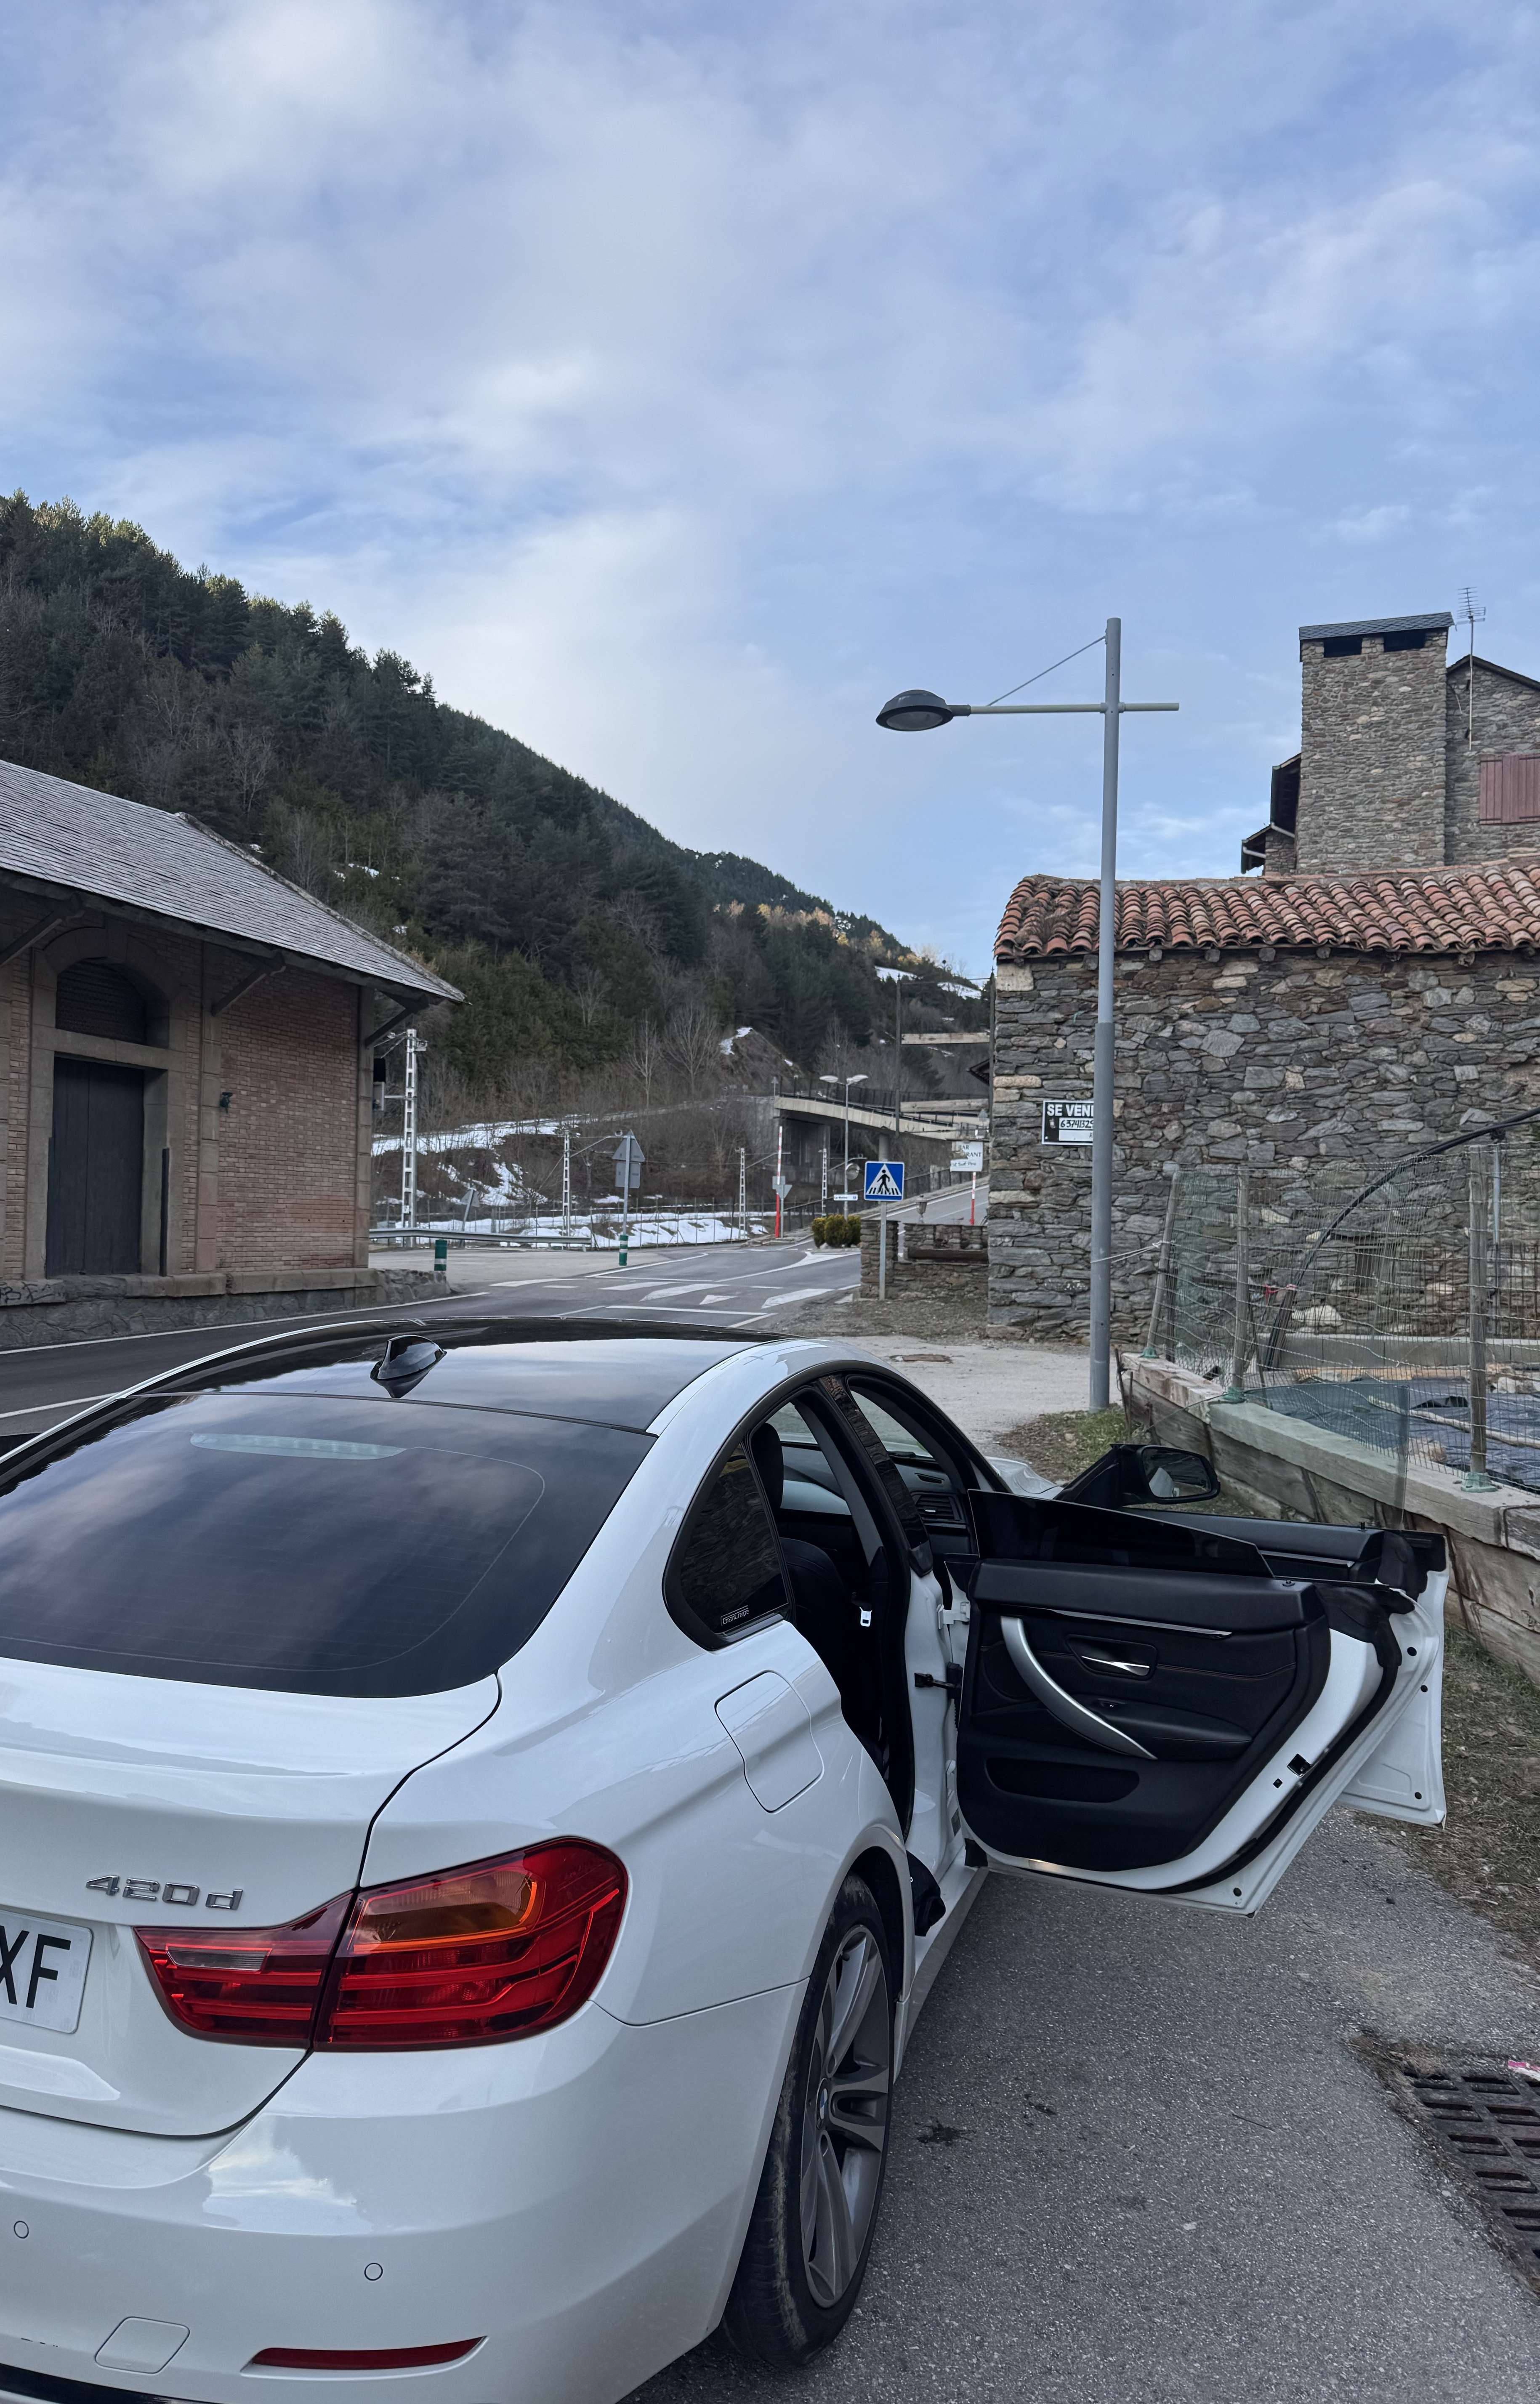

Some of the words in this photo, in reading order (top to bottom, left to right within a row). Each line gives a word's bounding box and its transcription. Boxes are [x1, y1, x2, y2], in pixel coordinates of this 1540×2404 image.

[1047, 1104, 1062, 1117] SE
[1066, 1104, 1094, 1117] VEN
[85, 1875, 243, 1910] 420d
[0, 1925, 71, 2009] XF
